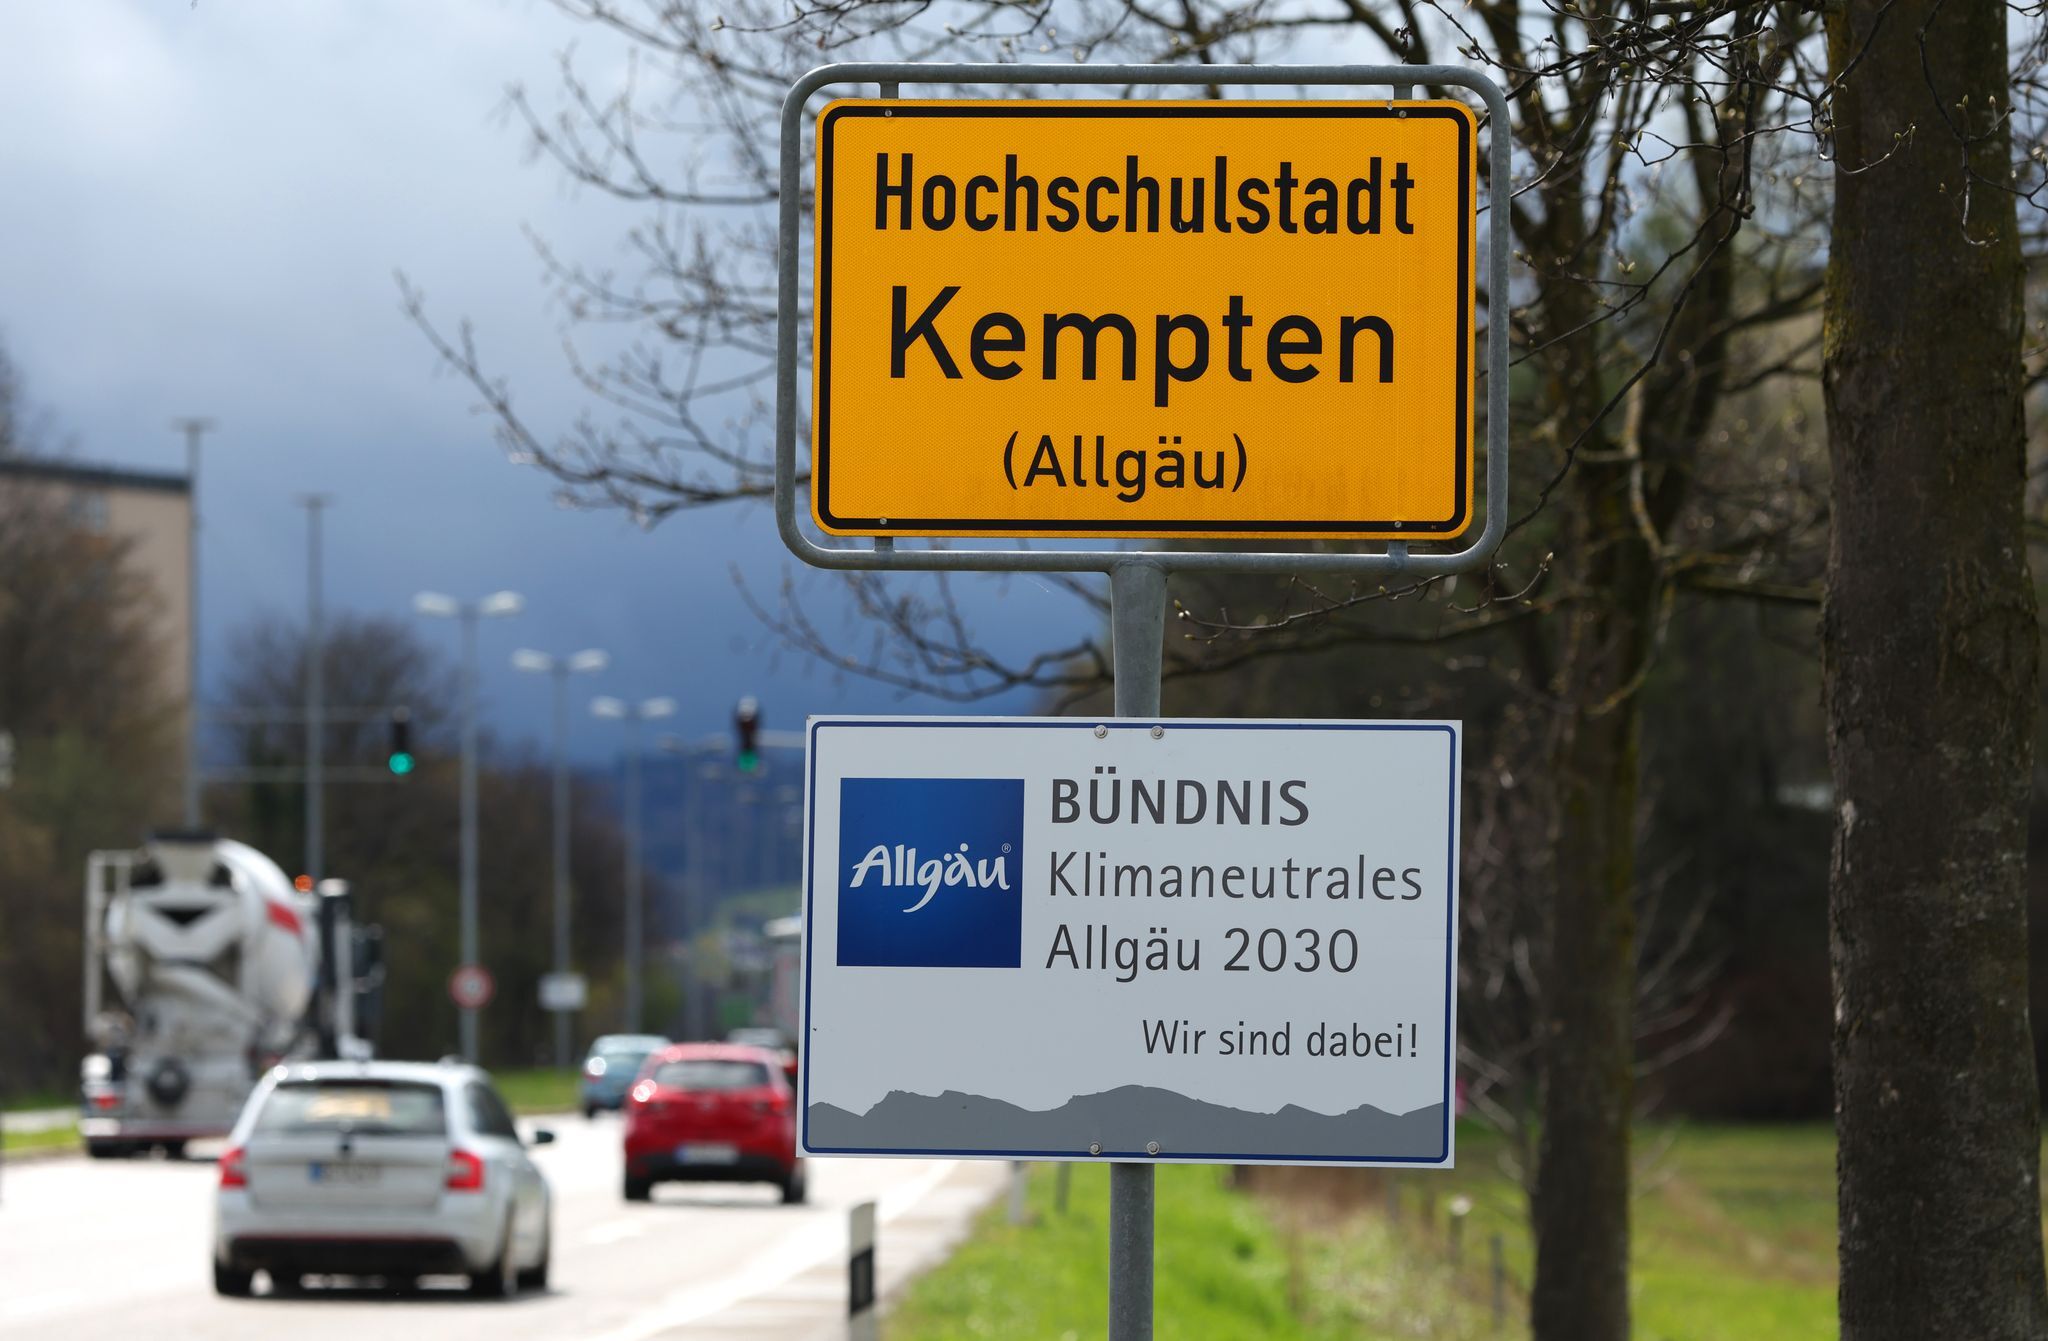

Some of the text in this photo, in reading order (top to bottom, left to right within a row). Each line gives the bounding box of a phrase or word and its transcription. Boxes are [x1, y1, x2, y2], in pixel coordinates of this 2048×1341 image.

[874, 152, 1416, 235] Hochschulstadt
[890, 285, 1395, 408] Kempten
[1003, 430, 1247, 503] (Allgäu)
[1051, 765, 1310, 827] BÜNDNIS
[1050, 851, 1422, 901] Klimaneutrales
[1045, 923, 1359, 983] Allgäu 2030
[1142, 1019, 1418, 1058] Wir sind dabei!
